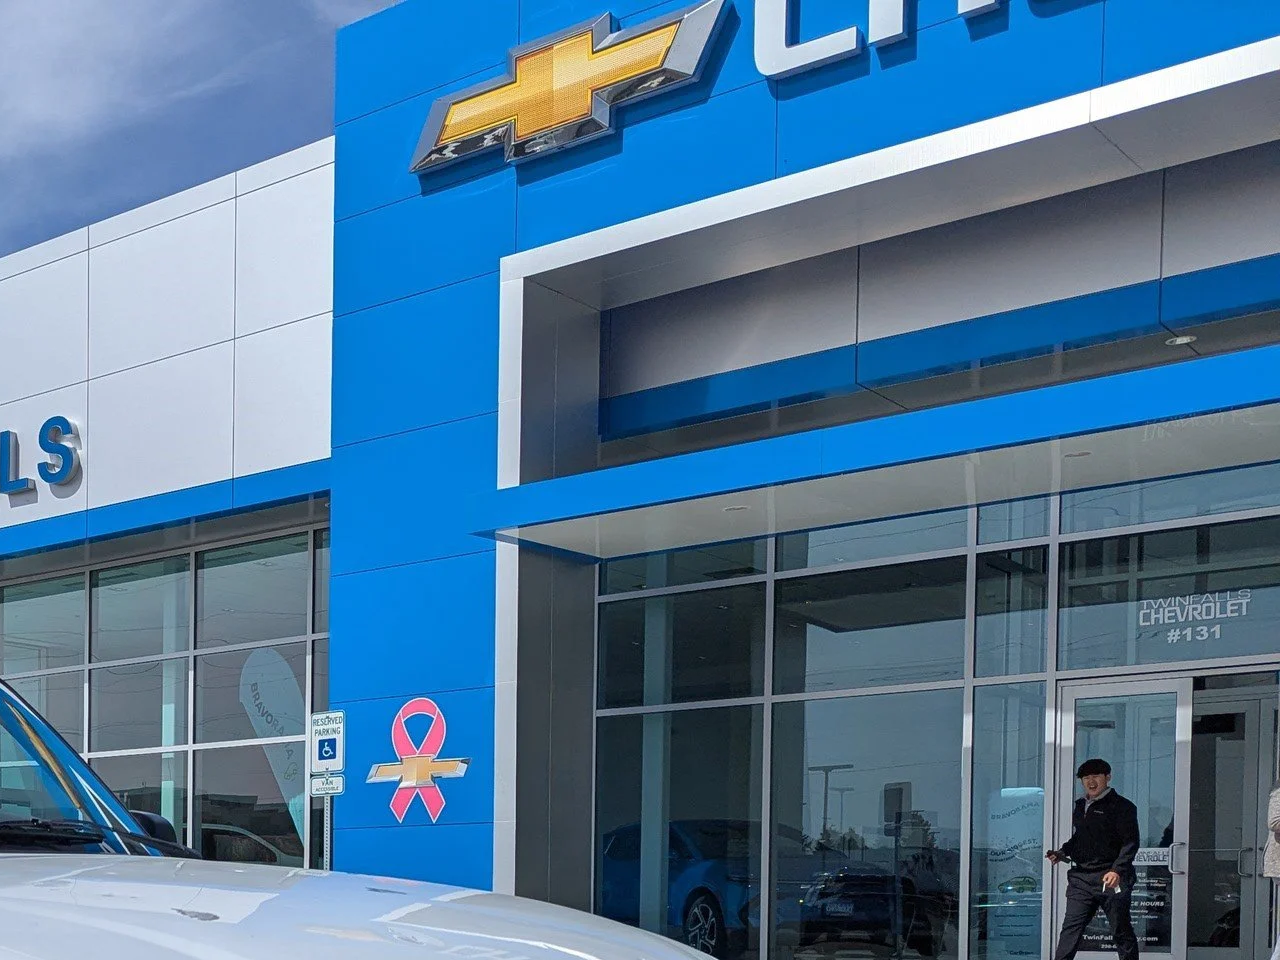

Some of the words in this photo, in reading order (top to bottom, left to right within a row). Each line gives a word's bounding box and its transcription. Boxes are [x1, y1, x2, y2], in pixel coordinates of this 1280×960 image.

[1139, 598, 1253, 627] CHEVROLET
[1167, 624, 1221, 643] #131
[250, 682, 295, 759] BRAVORAA
[312, 716, 343, 726] RESERVED
[314, 727, 341, 737] PARKING
